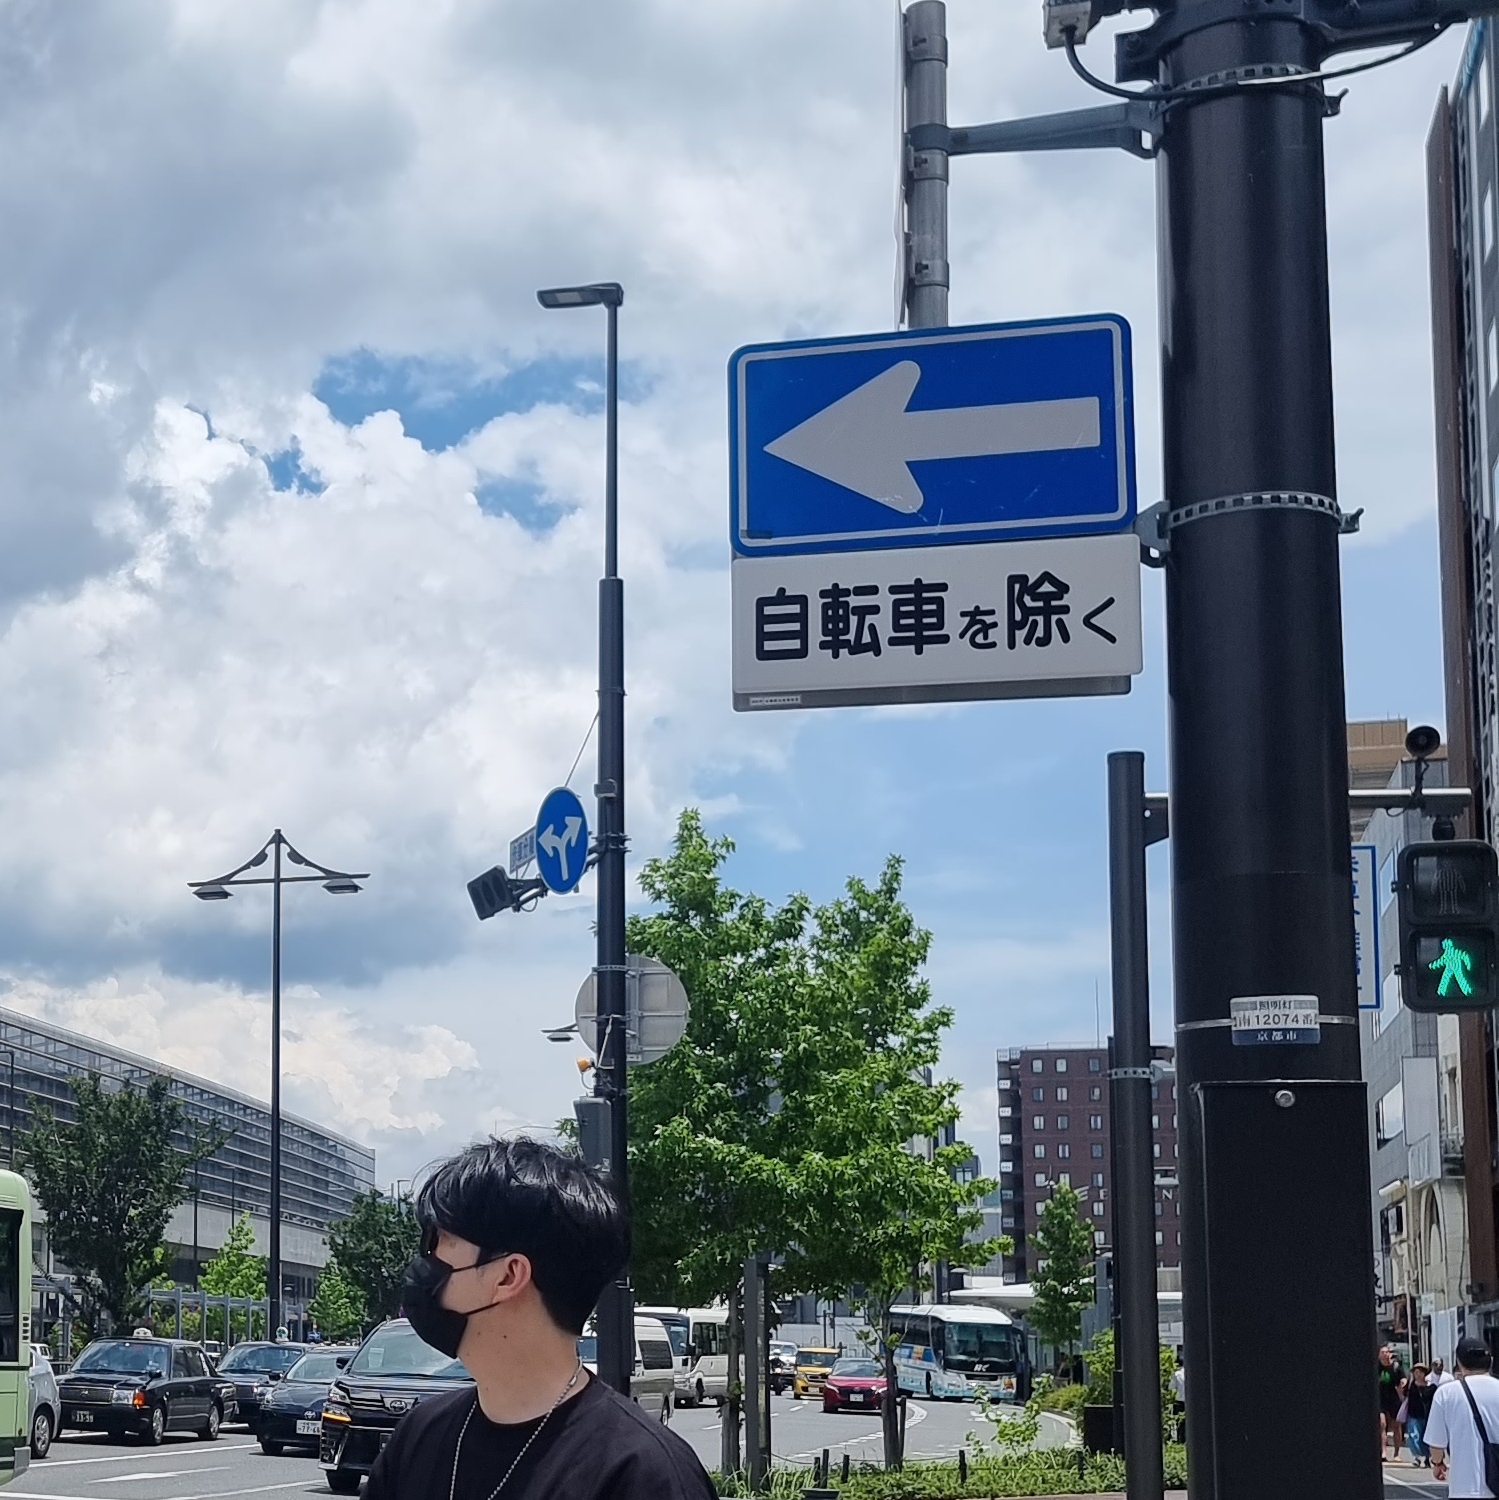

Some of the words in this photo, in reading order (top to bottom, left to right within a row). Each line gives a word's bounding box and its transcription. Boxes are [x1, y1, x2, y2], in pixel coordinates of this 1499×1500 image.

[755, 570, 1118, 662] 自転車を除く
[1254, 1012, 1300, 1026] 12074
